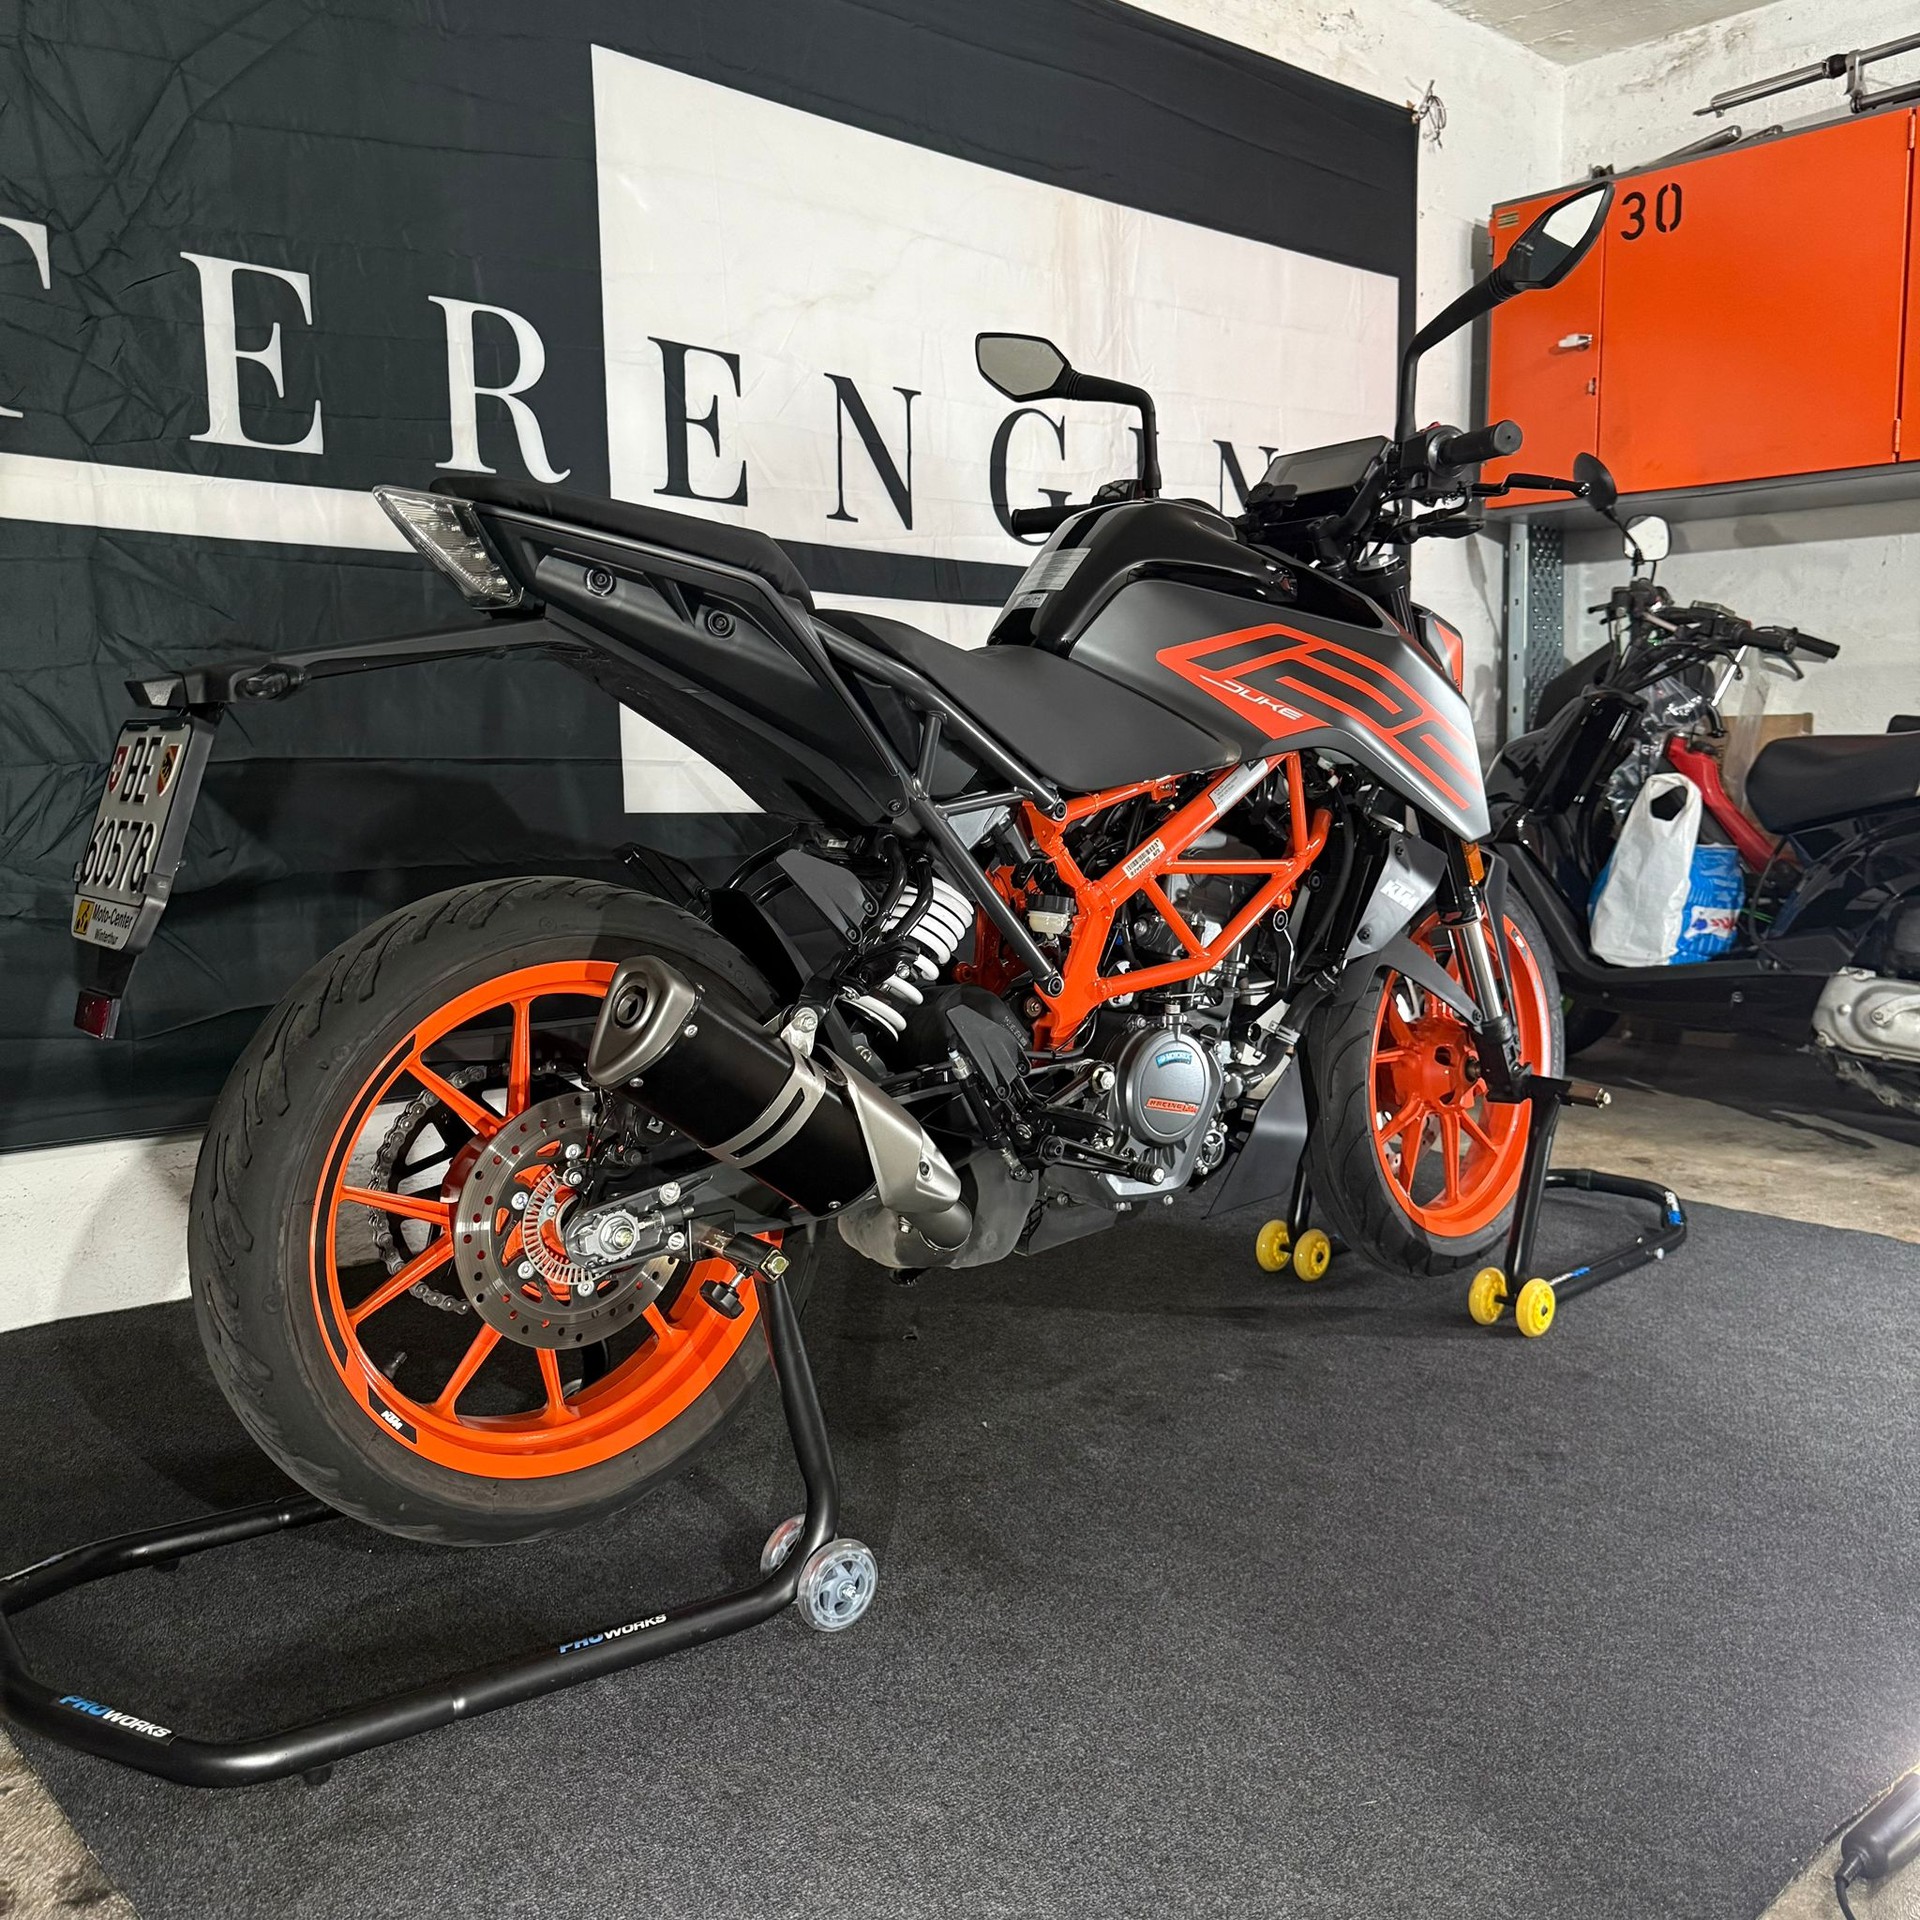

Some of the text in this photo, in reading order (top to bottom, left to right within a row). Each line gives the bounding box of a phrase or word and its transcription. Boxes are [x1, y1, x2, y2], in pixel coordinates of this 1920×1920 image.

[1621, 183, 1682, 240] 30
[1199, 675, 1304, 720] DUKE
[119, 735, 165, 805] BE
[82, 816, 157, 893] 60578
[1380, 879, 1420, 912] KTM
[380, 1410, 403, 1430] KTM
